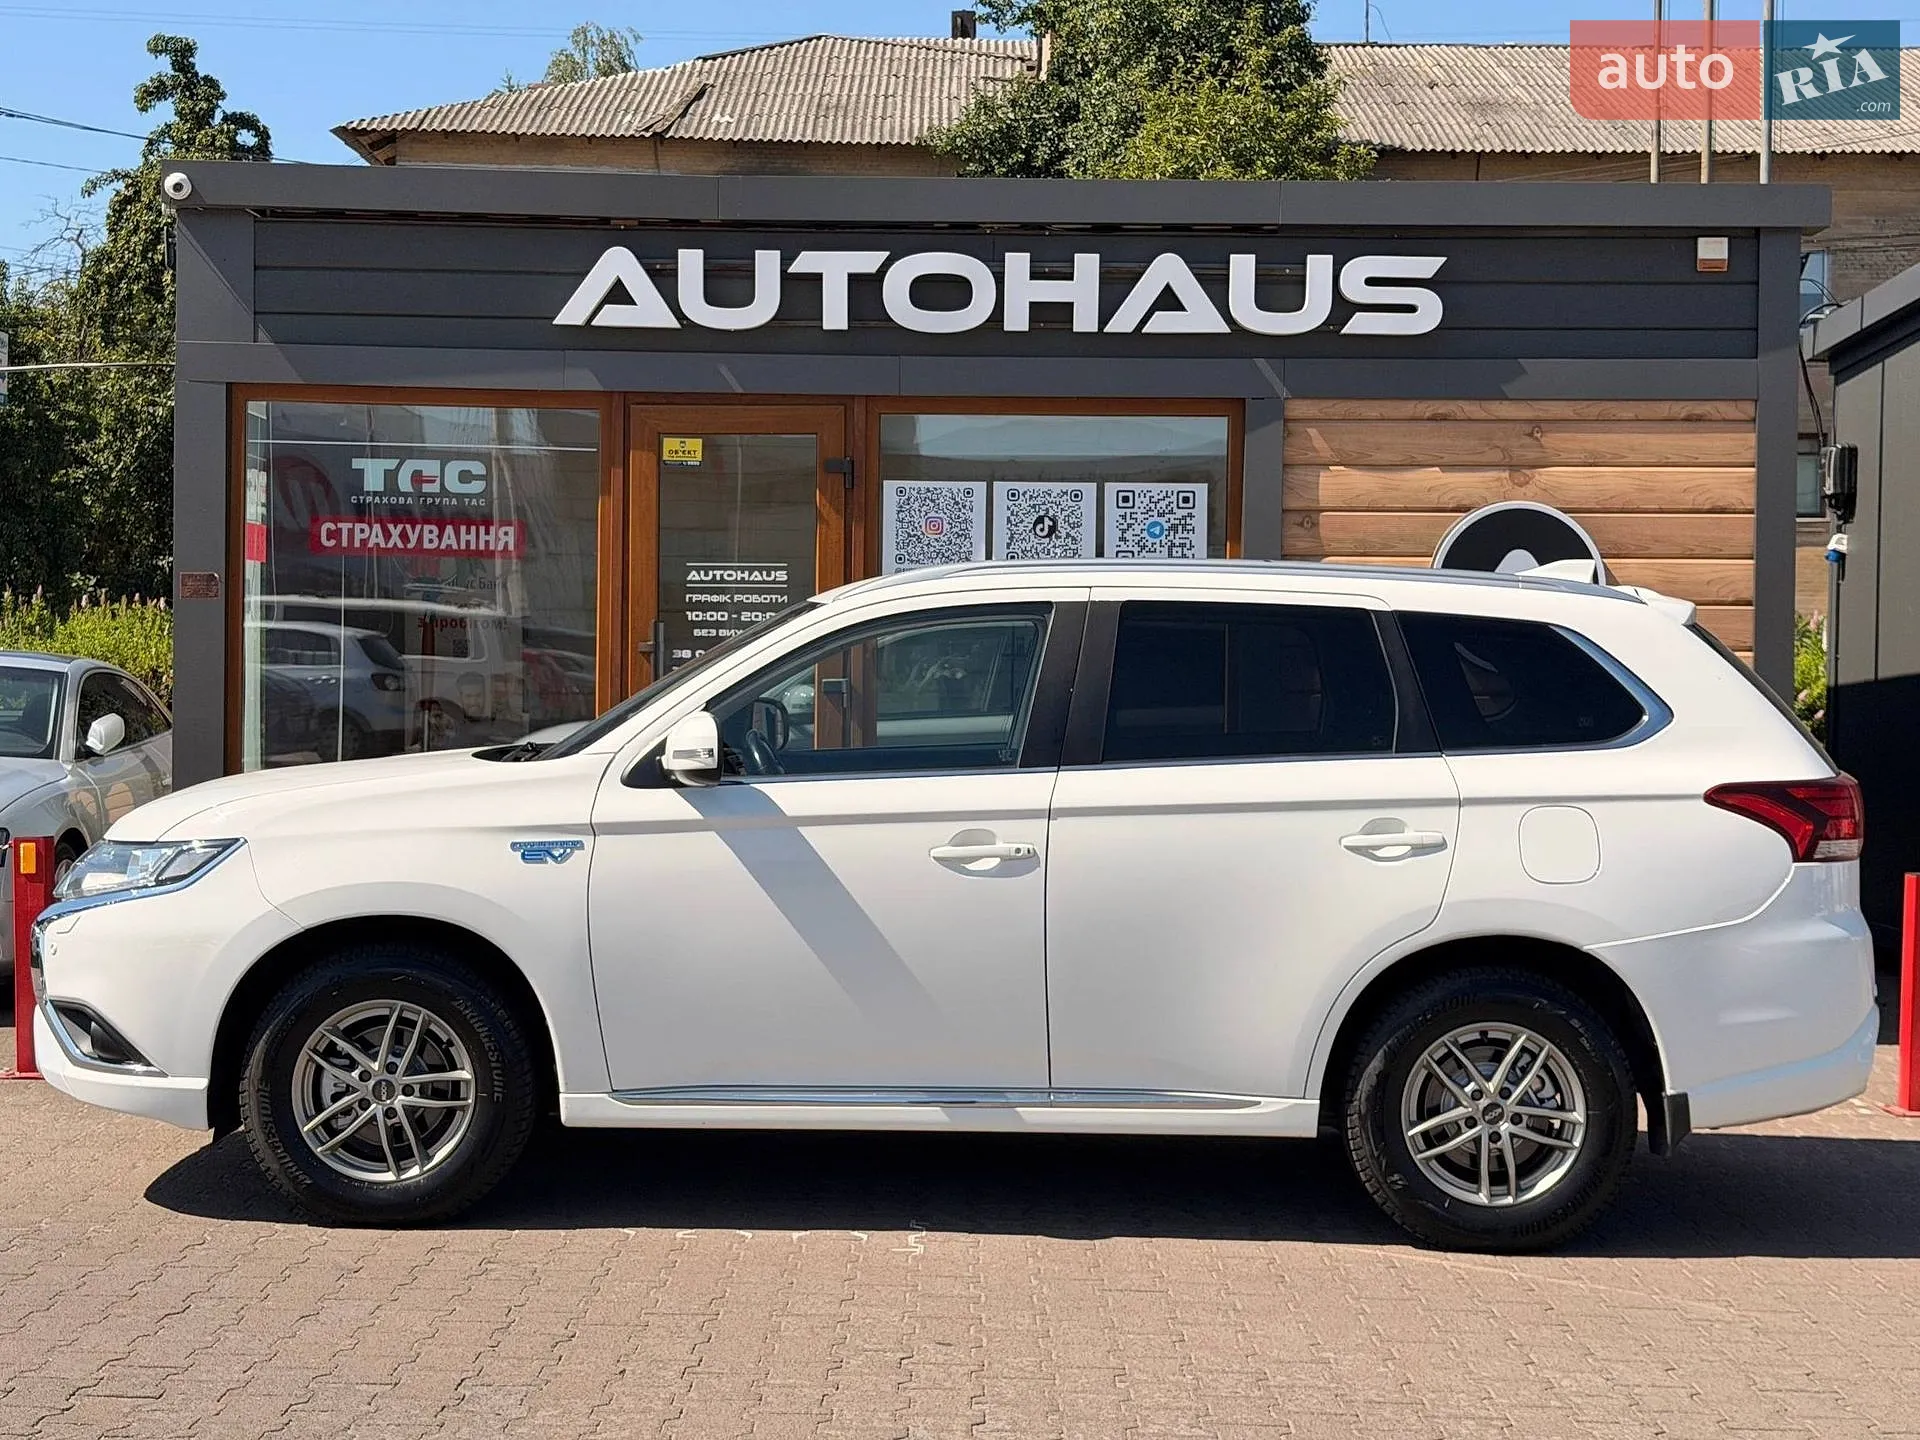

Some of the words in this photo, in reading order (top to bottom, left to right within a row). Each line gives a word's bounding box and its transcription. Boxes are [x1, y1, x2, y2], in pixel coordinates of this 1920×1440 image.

[552, 246, 1448, 335] AUTOHAUS
[350, 495, 413, 505] СТРАХОВА
[420, 497, 458, 505] ГРУПА
[464, 498, 486, 506] ТАС
[319, 521, 517, 551] СТРАХУВАННЯ
[686, 570, 788, 582] AUTOHAUS
[686, 594, 732, 603] ГРАФІК
[733, 594, 788, 603] РОБОТИ
[686, 611, 728, 621] 10:00
[693, 629, 717, 637] БЕЗ
